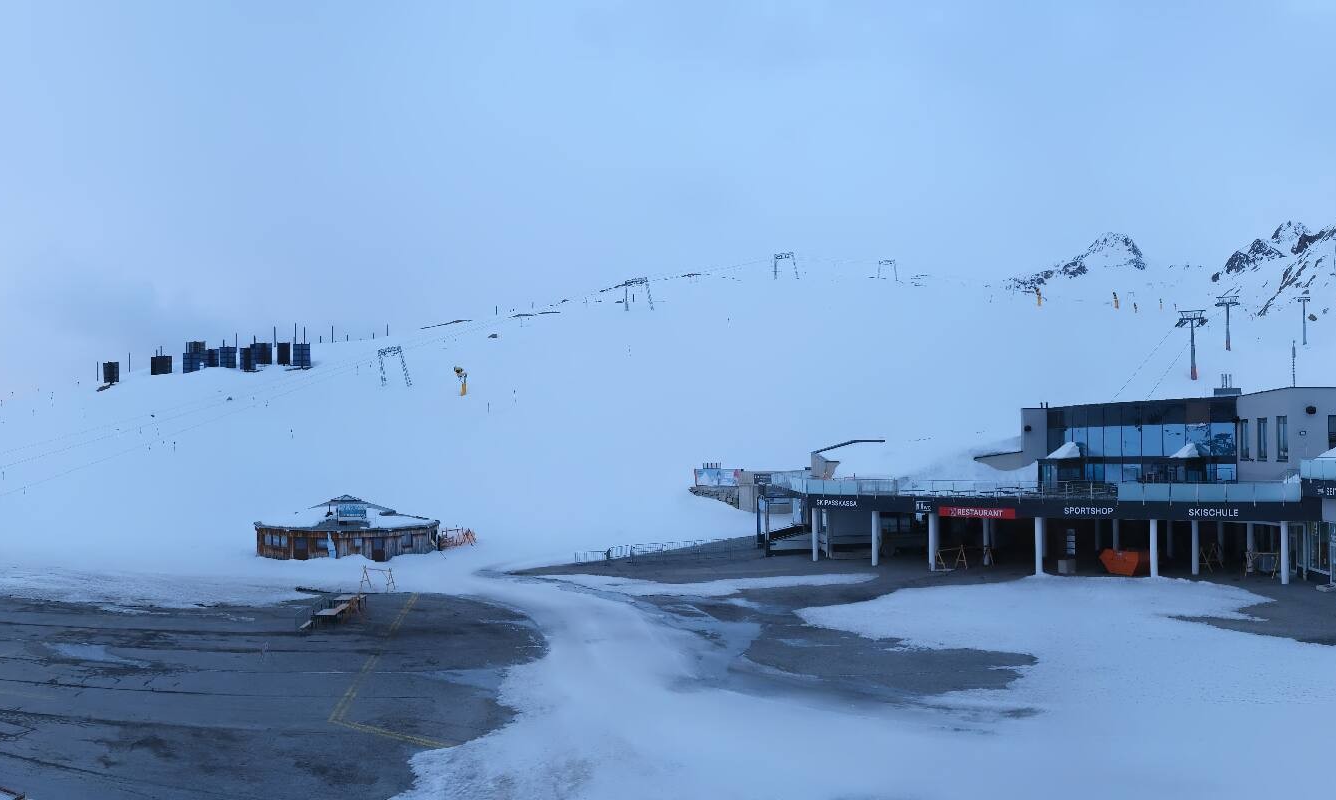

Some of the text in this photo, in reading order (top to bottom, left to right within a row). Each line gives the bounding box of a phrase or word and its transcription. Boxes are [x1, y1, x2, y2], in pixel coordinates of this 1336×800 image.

[956, 508, 1004, 518] RESTAURANT
[1064, 506, 1114, 515] SPORTSHOP
[1188, 508, 1239, 517] SKISCHULE
